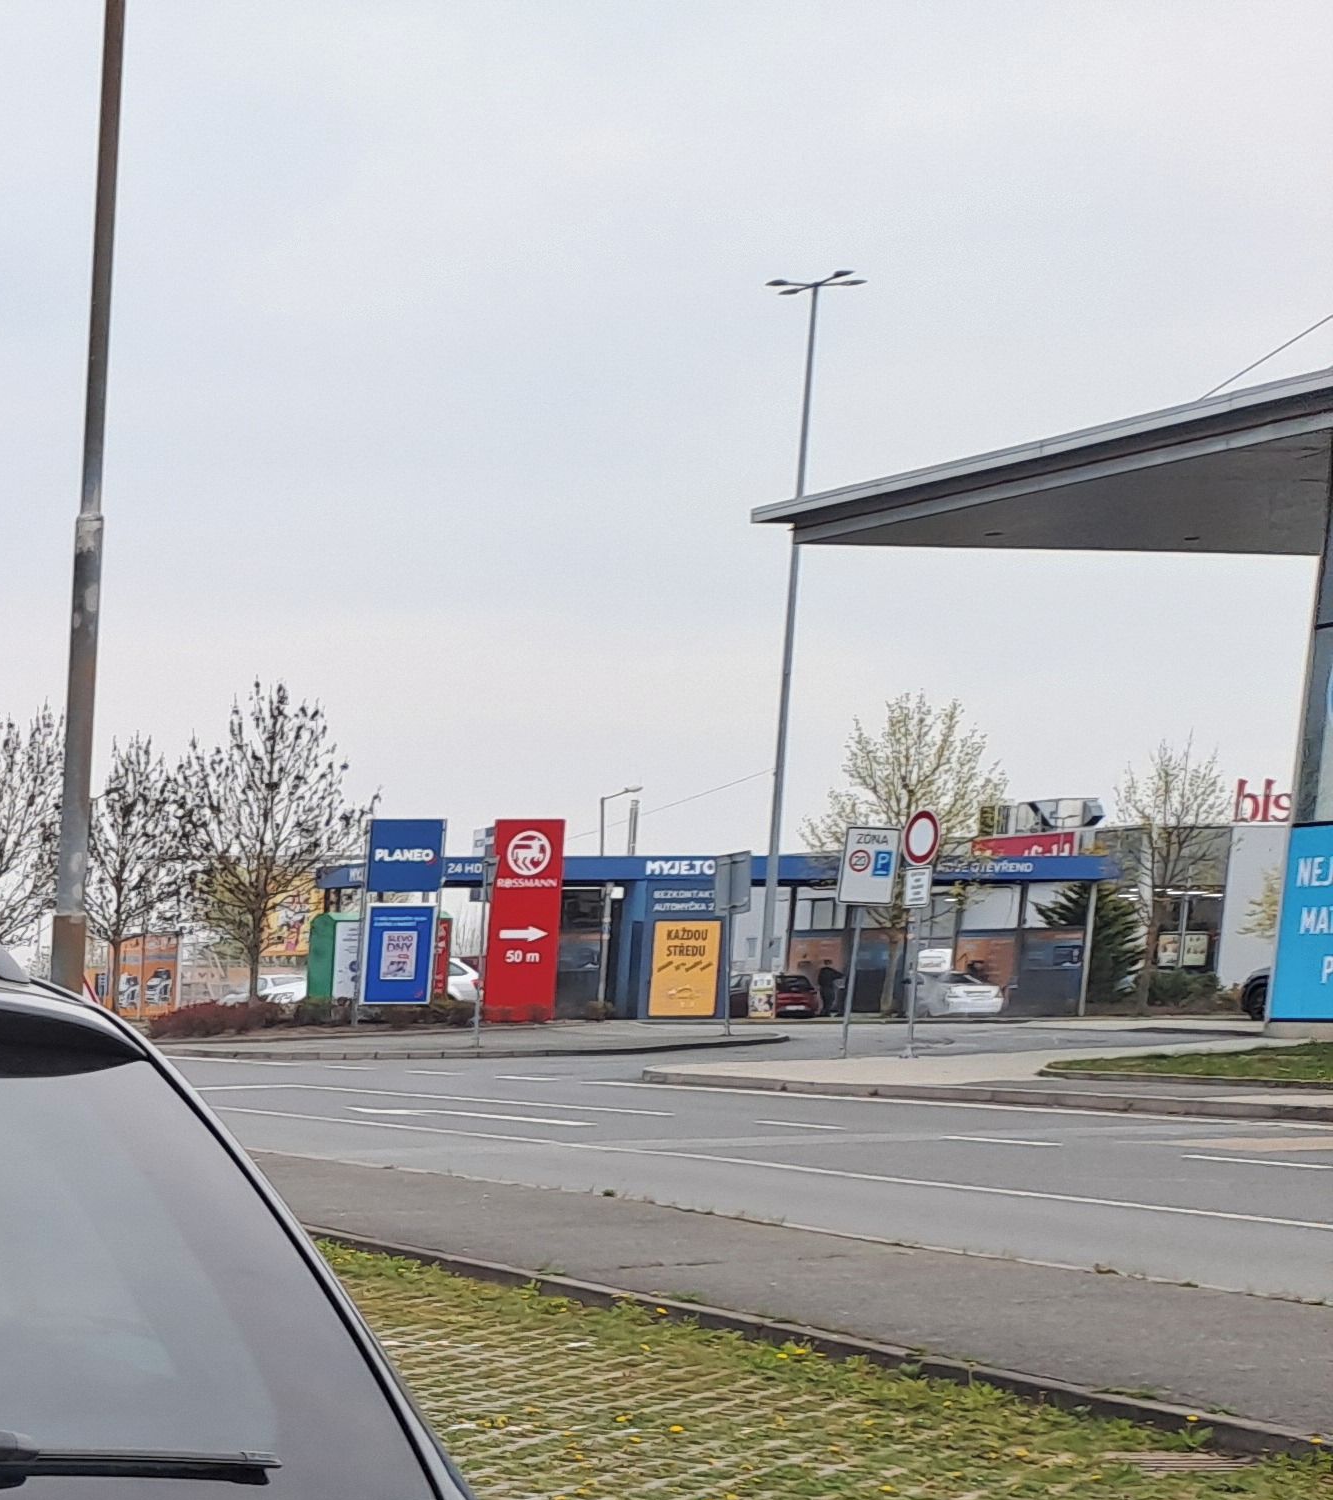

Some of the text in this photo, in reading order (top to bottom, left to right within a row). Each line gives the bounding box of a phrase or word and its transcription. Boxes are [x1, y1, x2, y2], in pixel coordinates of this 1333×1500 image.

[374, 848, 435, 862] PLANEO
[876, 853, 890, 869] P
[447, 863, 463, 874] 24
[496, 878, 558, 889] ROSSMANN
[666, 927, 709, 941] KAŽDOU
[505, 950, 540, 963] 50 m
[666, 943, 706, 957] STŘEDU
